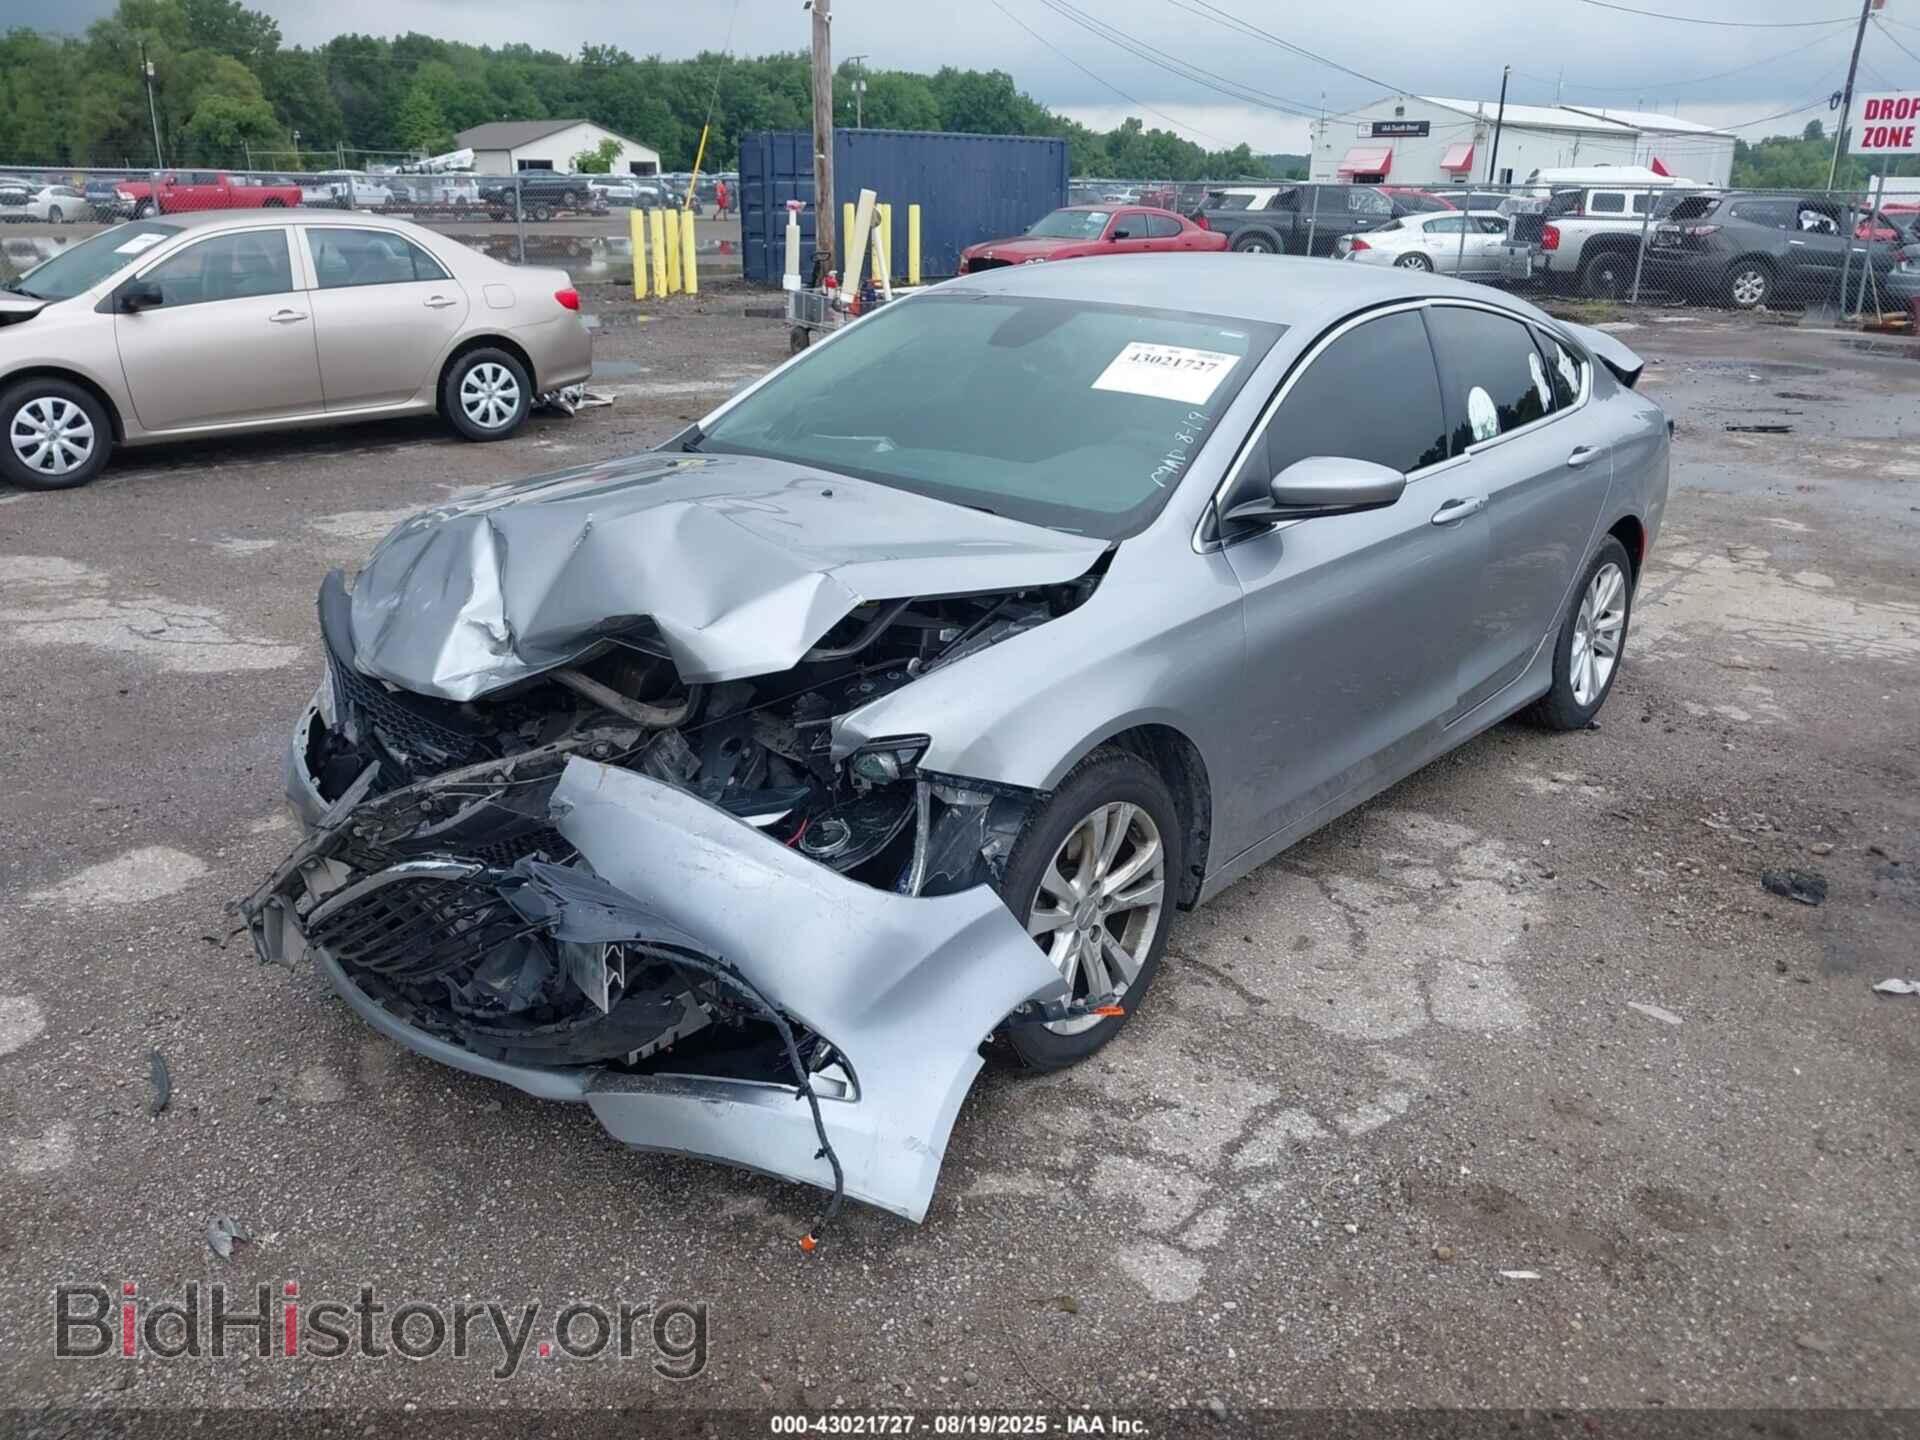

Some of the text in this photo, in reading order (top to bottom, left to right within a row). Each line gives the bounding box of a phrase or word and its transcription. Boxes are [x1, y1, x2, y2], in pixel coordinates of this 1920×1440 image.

[1861, 126, 1915, 148] ZONE
[1128, 352, 1218, 372] 43021727
[1174, 411, 1211, 444] 8-19
